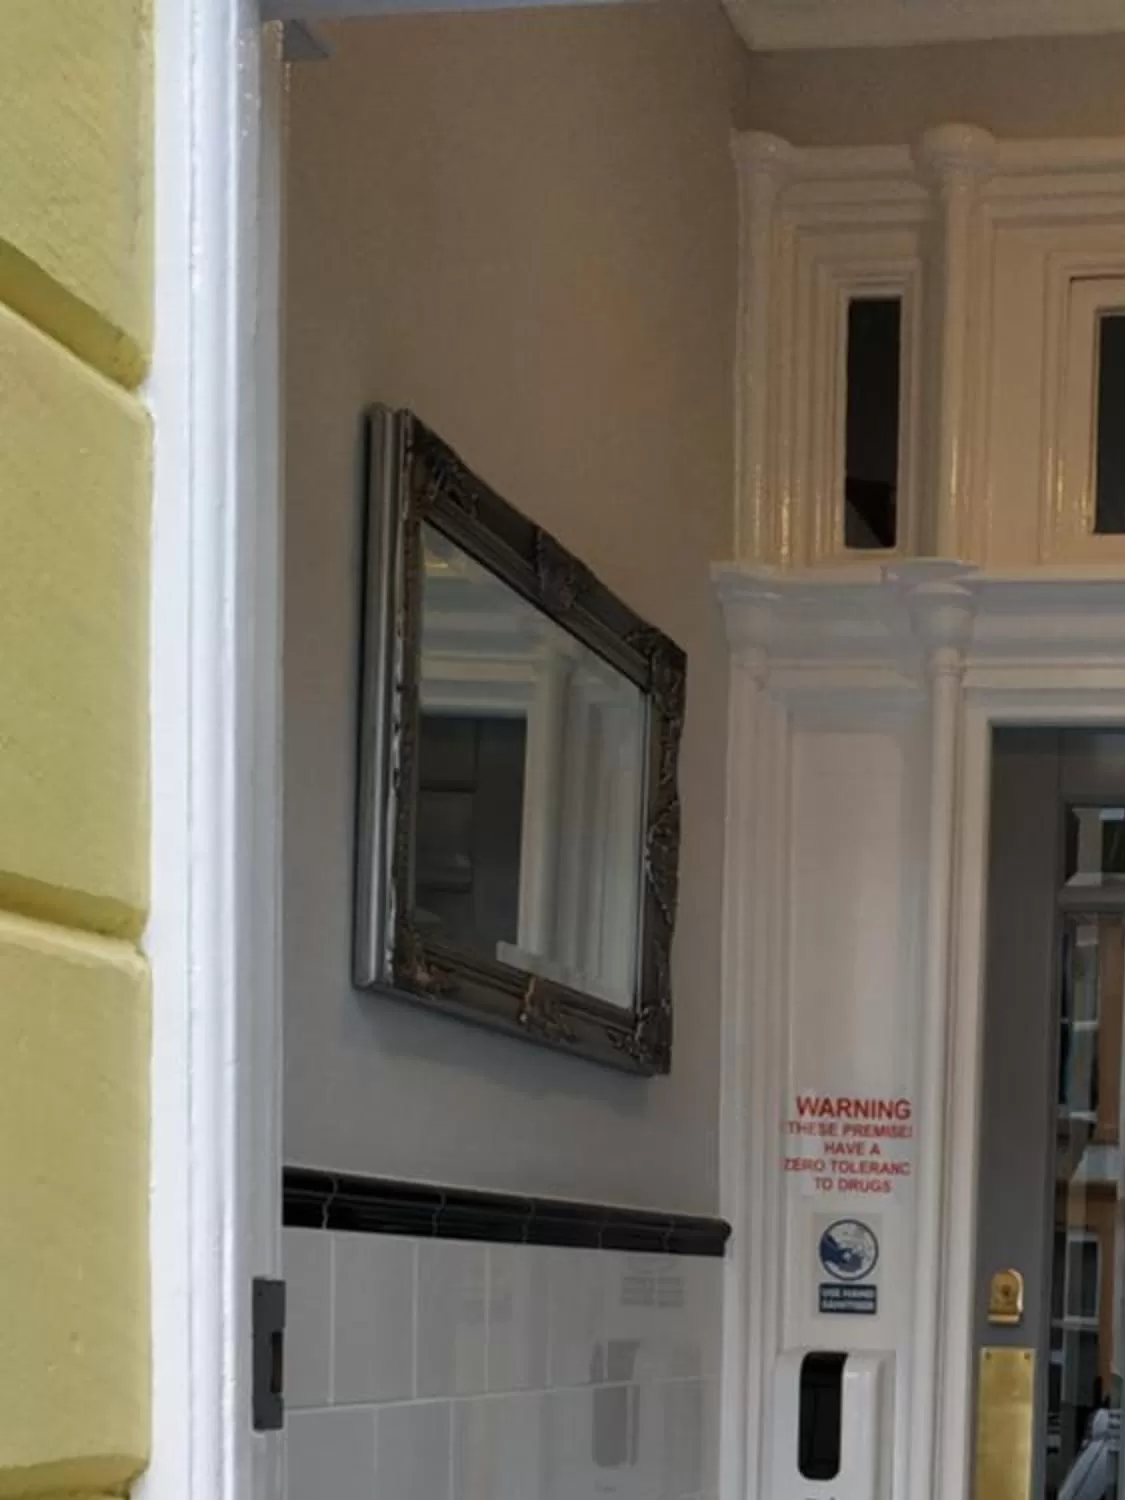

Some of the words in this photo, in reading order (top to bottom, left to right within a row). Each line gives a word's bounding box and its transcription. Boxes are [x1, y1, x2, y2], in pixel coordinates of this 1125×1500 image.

[796, 1096, 911, 1120] WARNING
[843, 1124, 912, 1138] PREMISE
[823, 1142, 864, 1155] HAVE
[868, 1143, 881, 1155] A
[784, 1157, 825, 1171] ZERO
[829, 1159, 911, 1175] TOLERANC
[814, 1176, 833, 1190] TO
[837, 1177, 891, 1193] DRUGS
